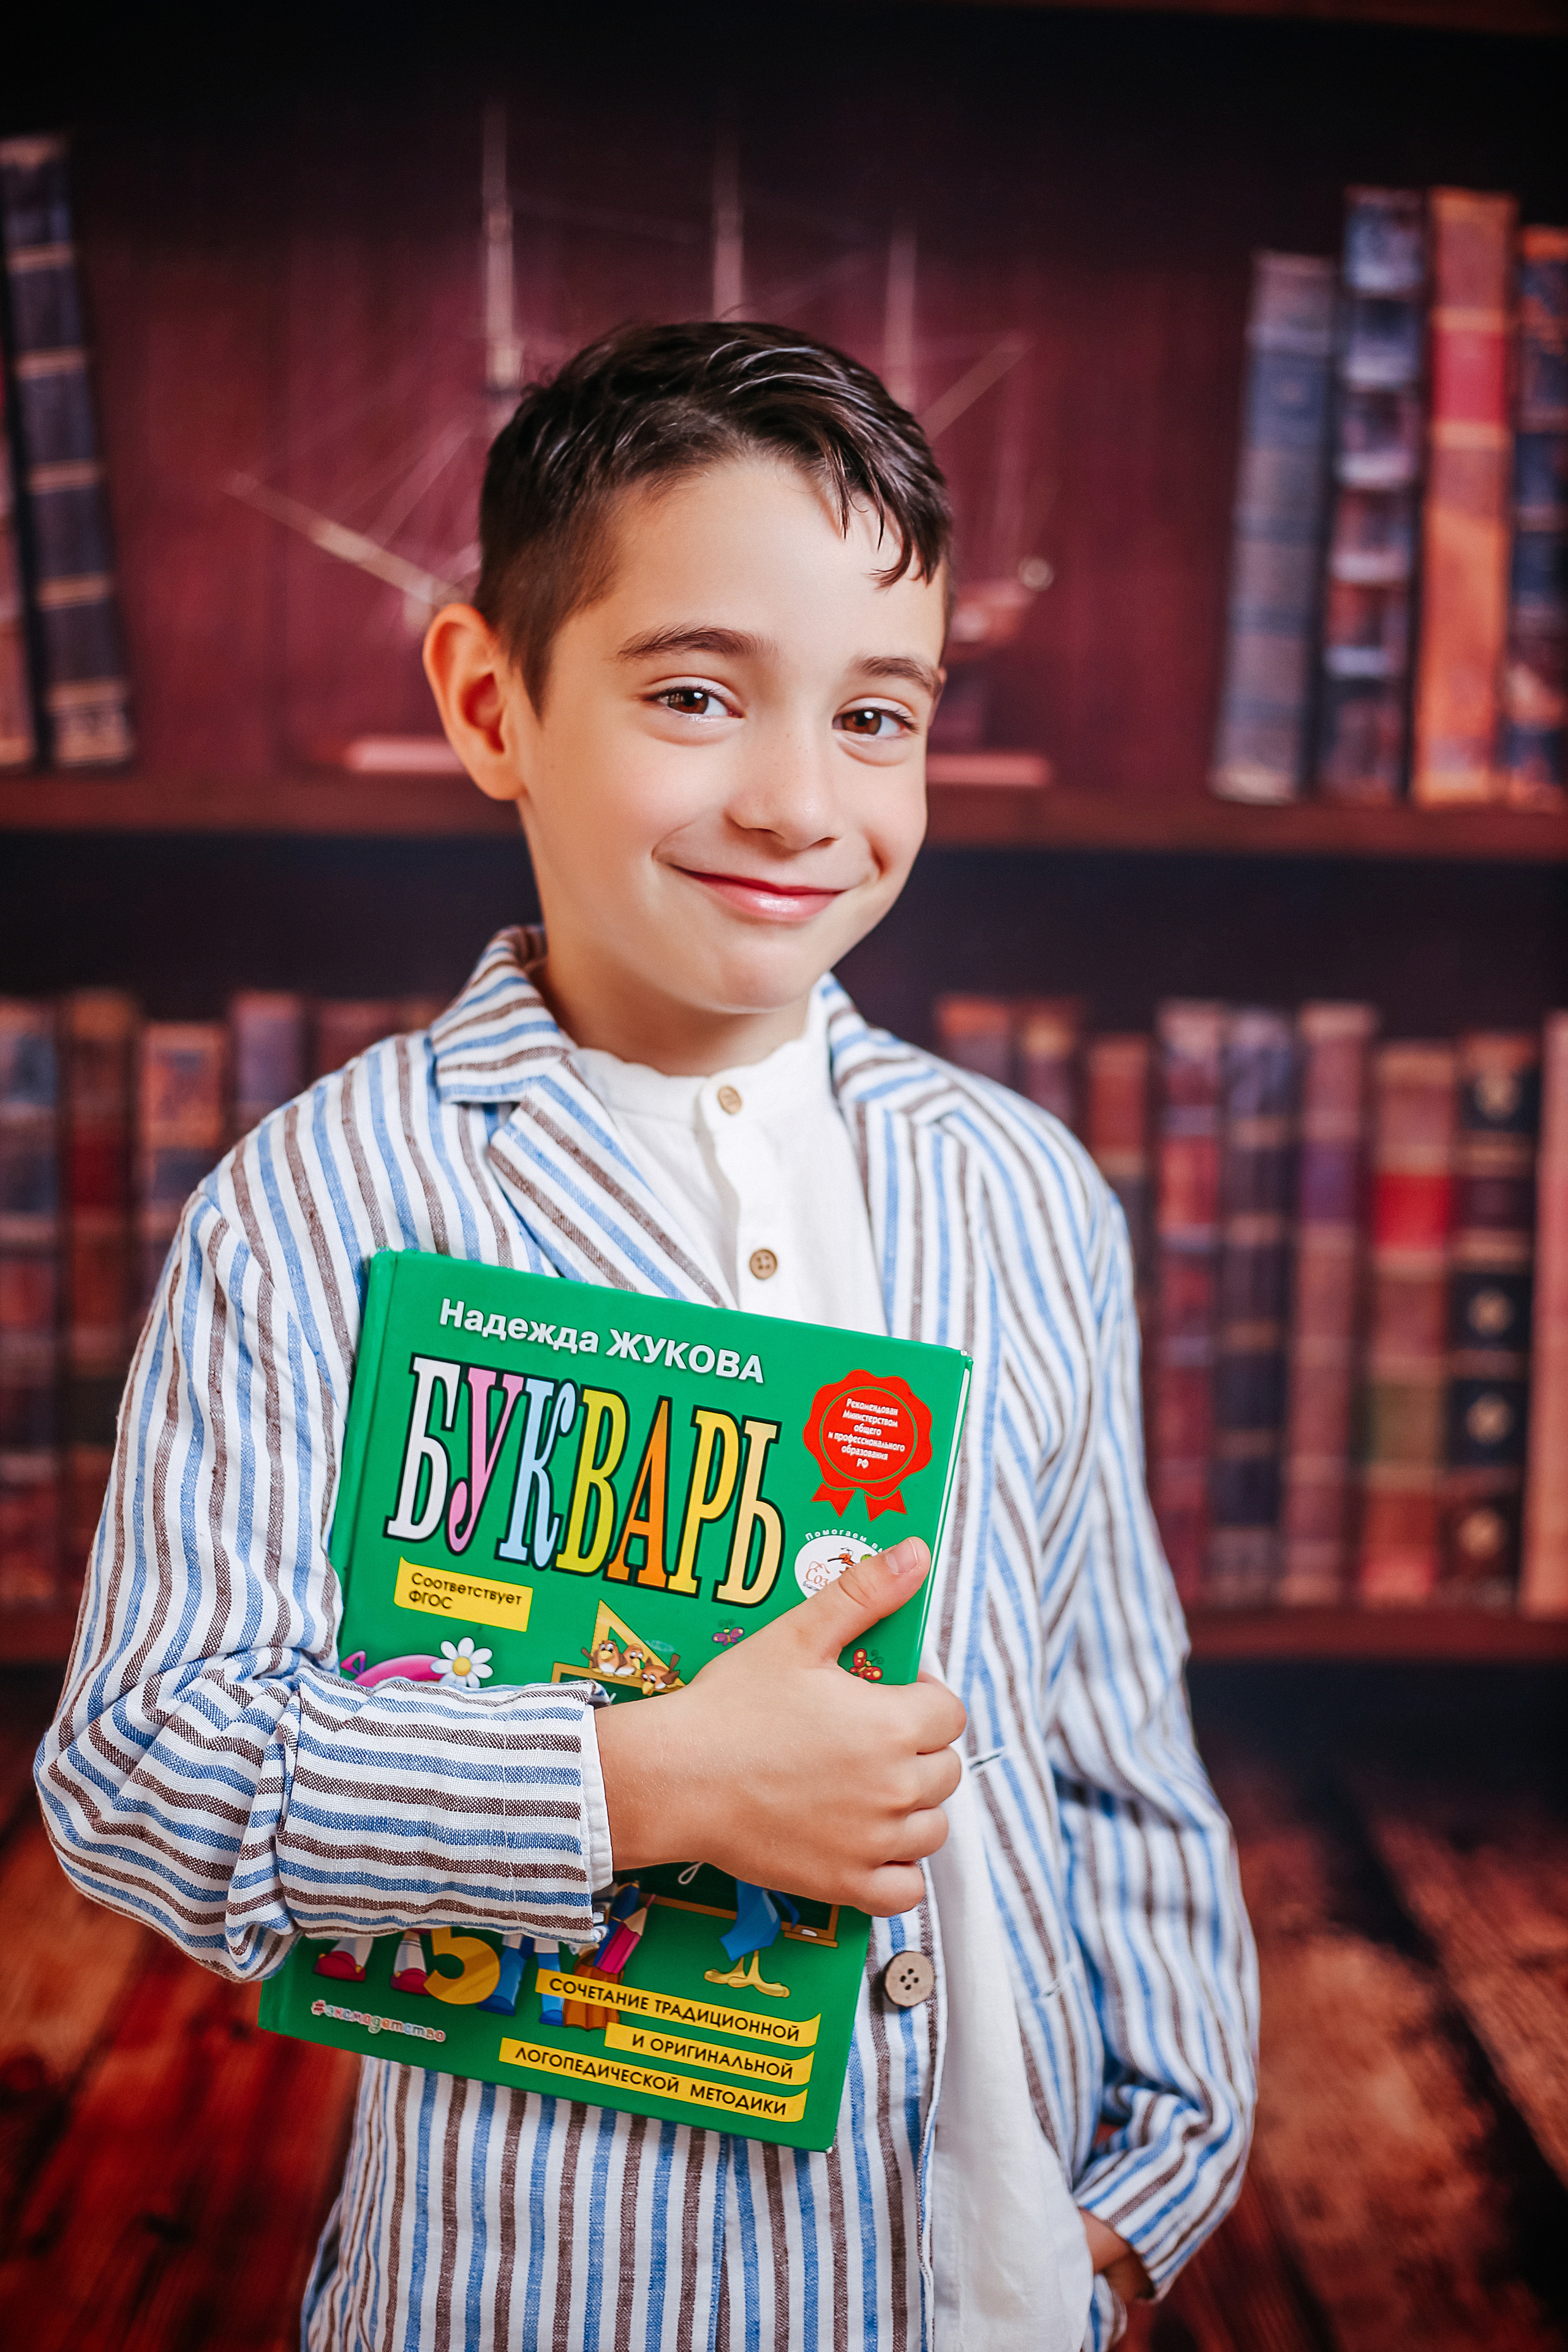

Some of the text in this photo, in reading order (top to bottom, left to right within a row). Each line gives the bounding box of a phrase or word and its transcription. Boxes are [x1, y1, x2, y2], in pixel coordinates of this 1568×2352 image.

[439, 1298, 765, 1384] Надежда ЖУКОВА
[846, 1398, 899, 1416] Рекомендован
[842, 1409, 899, 1428] Министерством
[853, 1423, 882, 1436] общего
[834, 1432, 905, 1452] профессионального
[841, 1444, 889, 1461] образования
[856, 1458, 869, 1469] РФ
[385, 1353, 785, 1608] БУКВАРЬ
[805, 1529, 867, 1542] Помогаем
[411, 1572, 522, 1605] Соответствует
[409, 1590, 454, 1609] ФГОС
[549, 1977, 800, 2042] СОЧЕТАНИЕ ТРАДИЦИОННОЙ
[311, 1999, 446, 2043] #эксмодетство
[631, 2034, 794, 2079] И ОРИГИНАЛЬНОЙ
[515, 2047, 788, 2116] ЛОГОПЕДИЧЕСКОЙ МЕТОДИКИ
